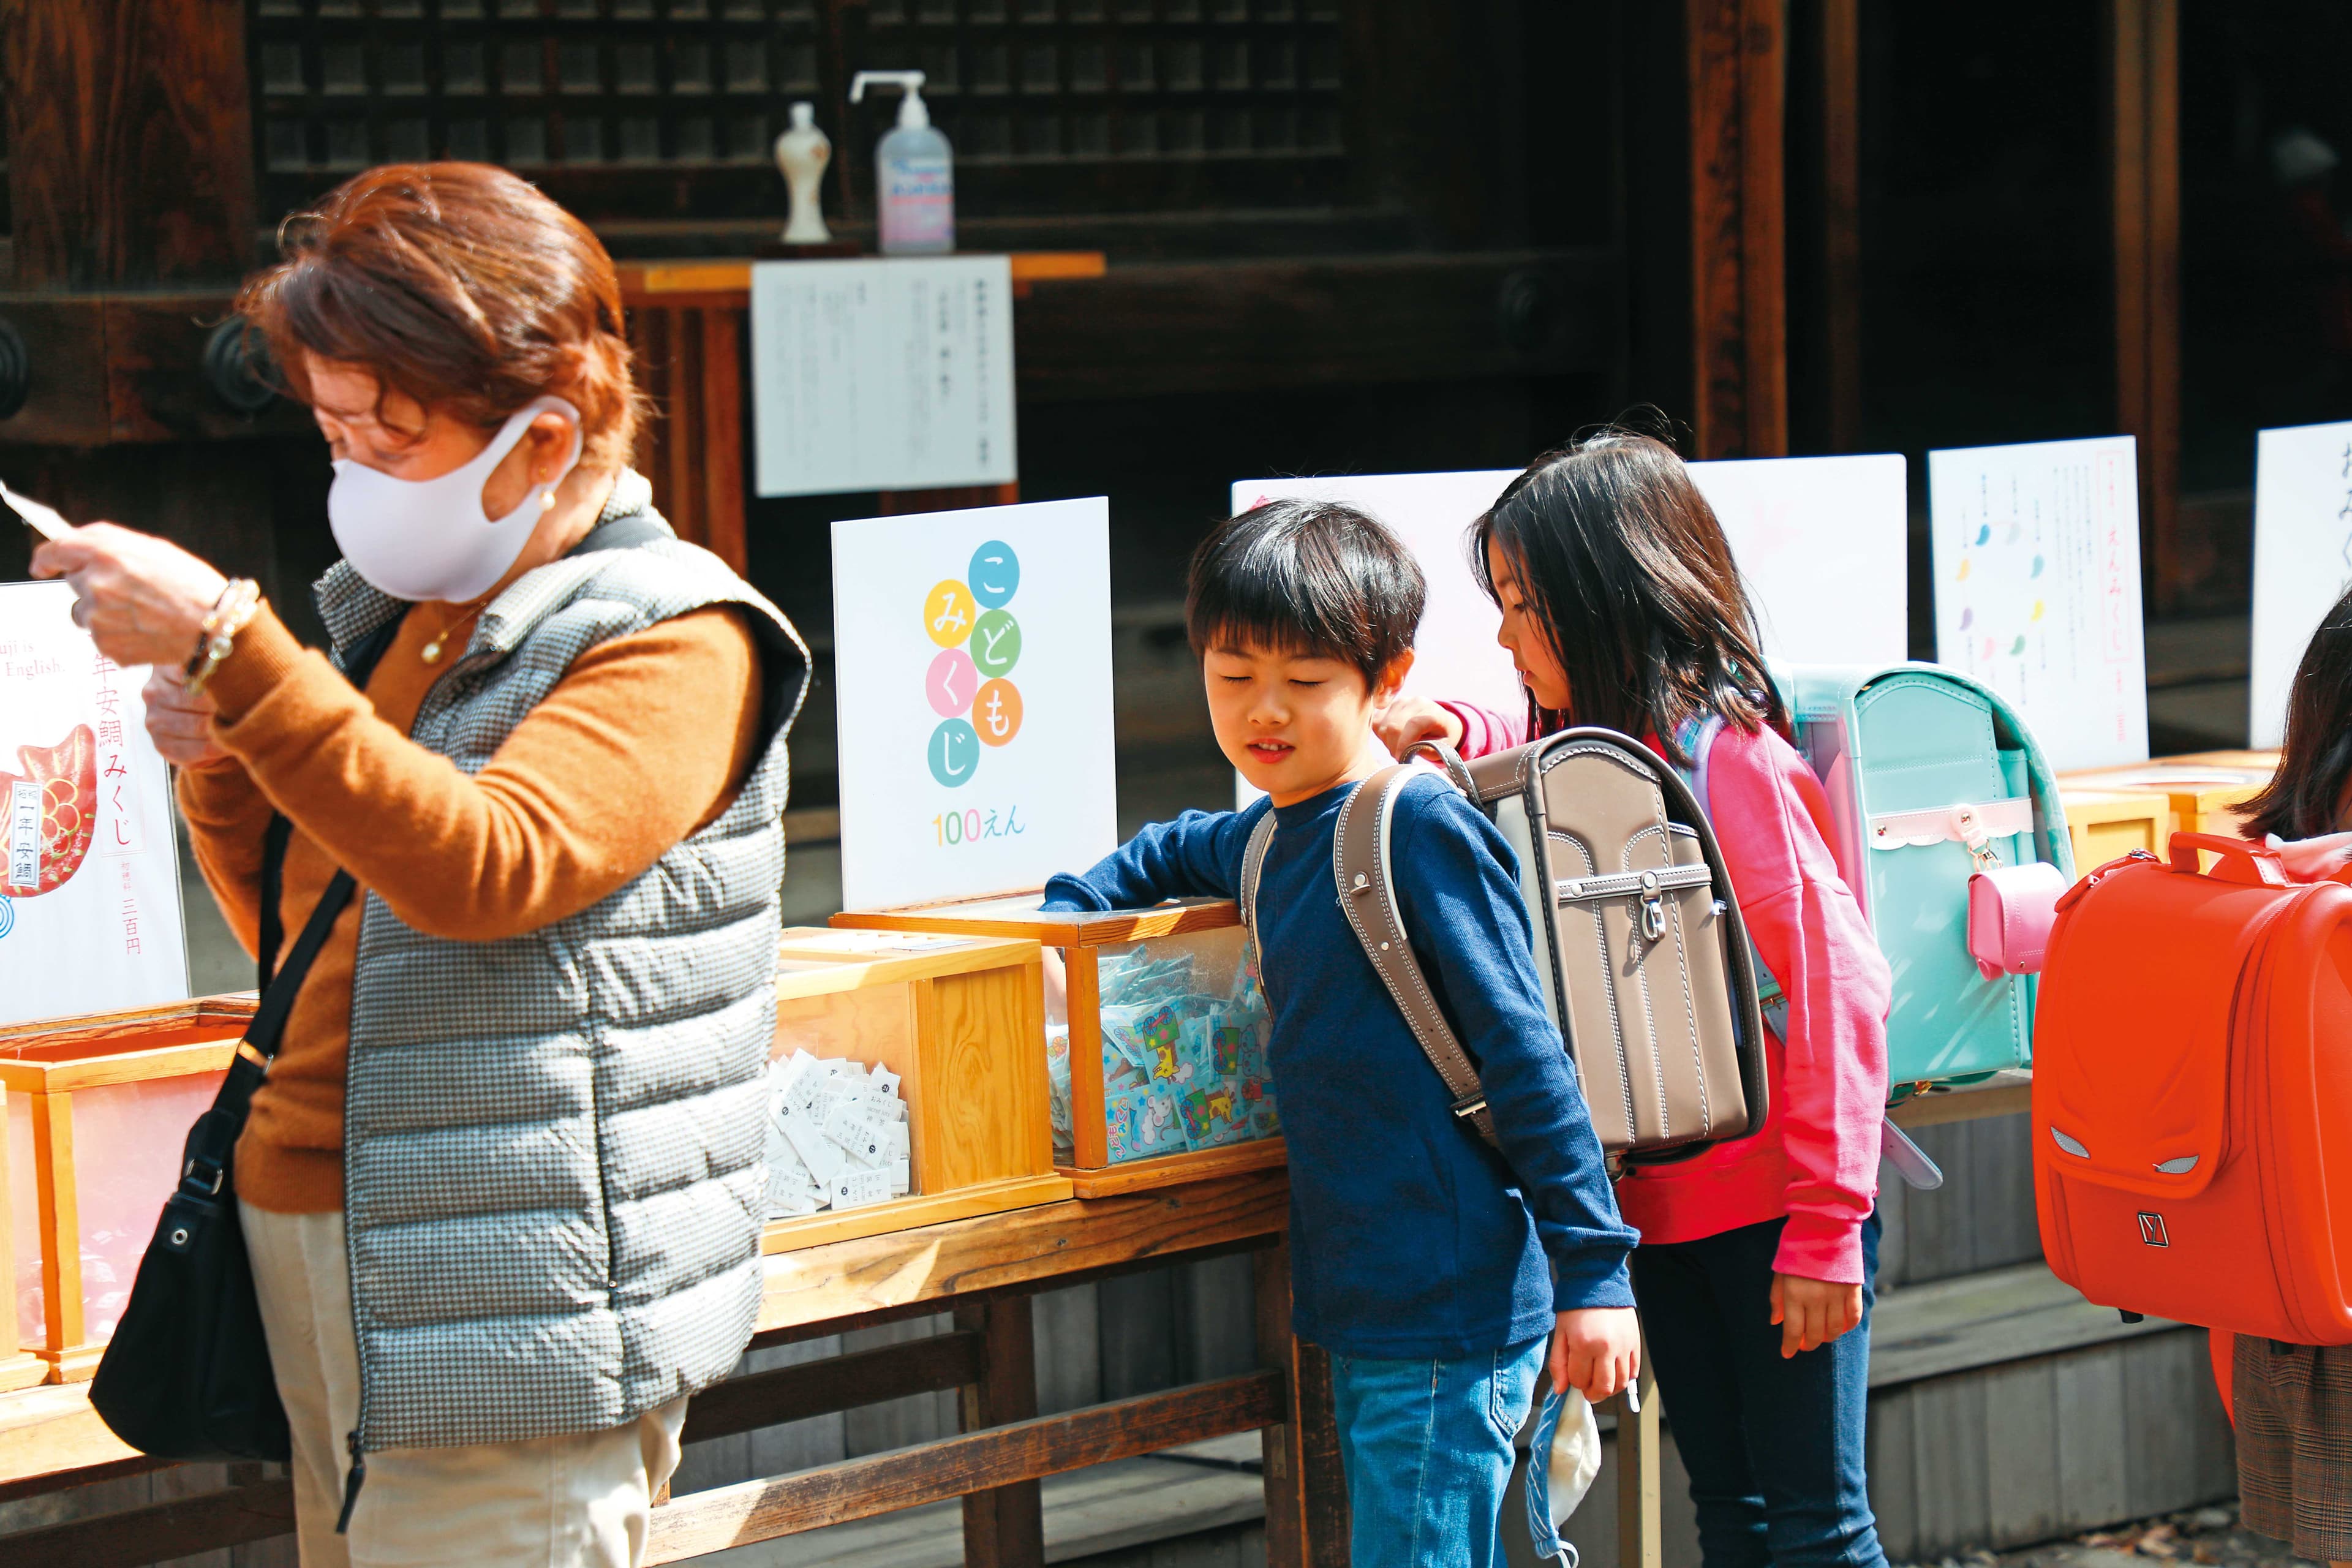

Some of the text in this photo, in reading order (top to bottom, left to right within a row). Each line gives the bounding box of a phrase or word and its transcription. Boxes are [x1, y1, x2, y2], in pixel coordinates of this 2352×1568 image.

[933, 592, 967, 776] みくじ
[983, 556, 1014, 737] こども
[932, 805, 1026, 847] 100えん
[122, 898, 141, 955] 三百円
